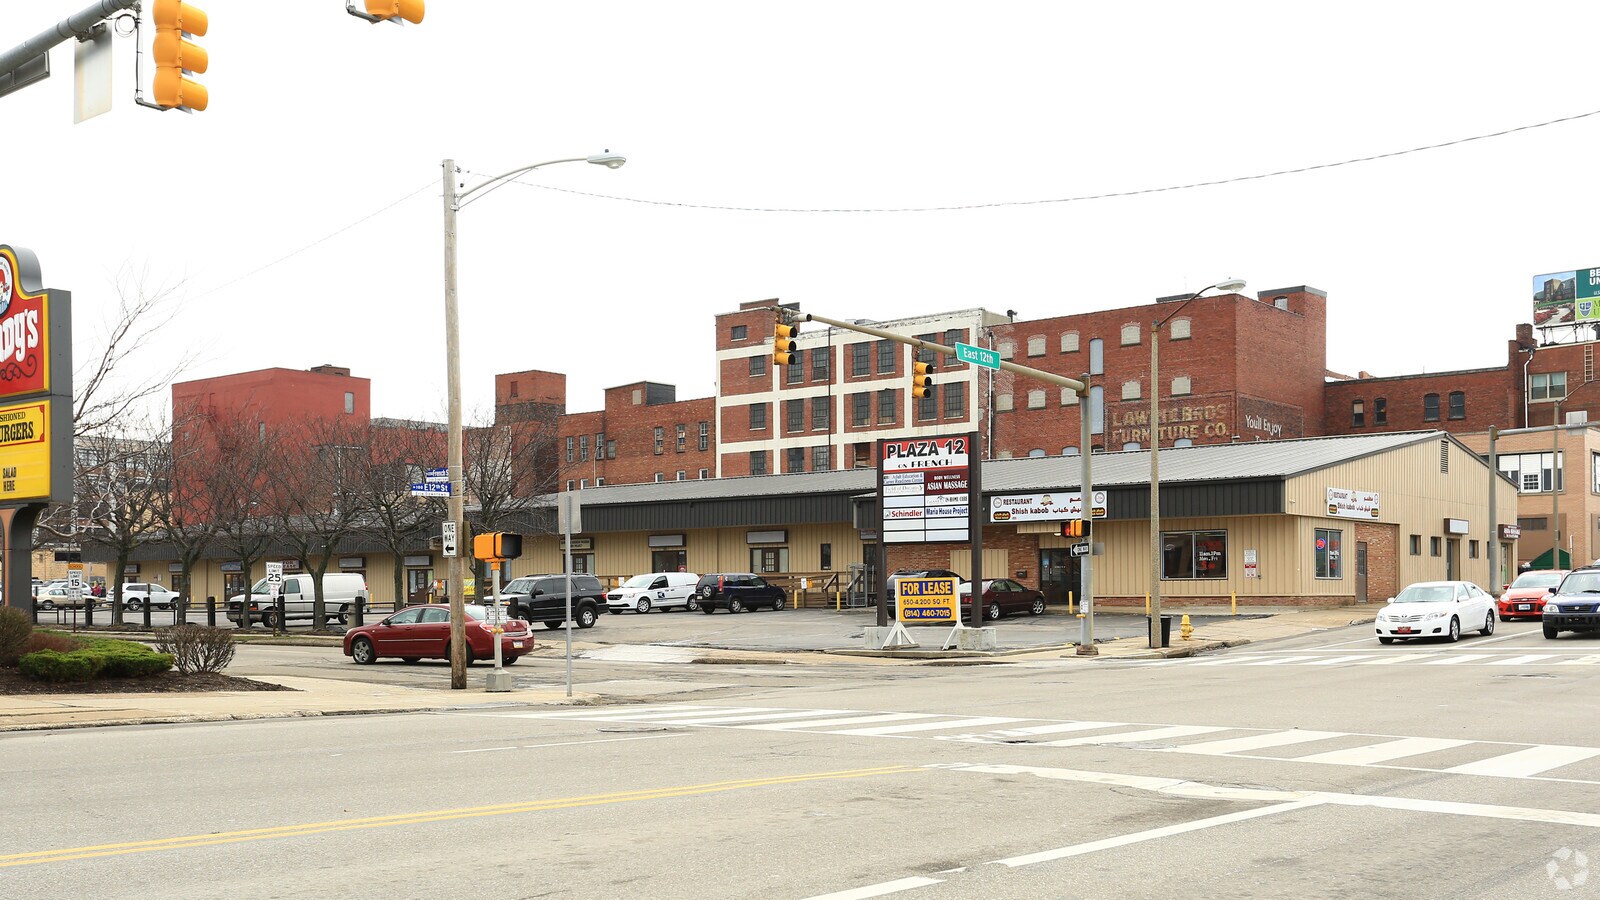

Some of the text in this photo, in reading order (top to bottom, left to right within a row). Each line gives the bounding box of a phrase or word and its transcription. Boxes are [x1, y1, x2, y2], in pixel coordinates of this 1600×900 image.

[963, 347, 994, 364] East 12th
[1112, 424, 1199, 442] FURNTURE
[1264, 419, 1282, 438] Enjoy
[886, 438, 965, 459] PLAZA 12
[911, 459, 953, 467] FRENCH
[3, 467, 16, 479] SALAD
[3, 480, 15, 492] HERE
[927, 480, 968, 490] ASIAN MASSAGE
[953, 507, 968, 515] Project
[444, 524, 454, 532] ONE
[902, 582, 951, 594] FOR LEASE
